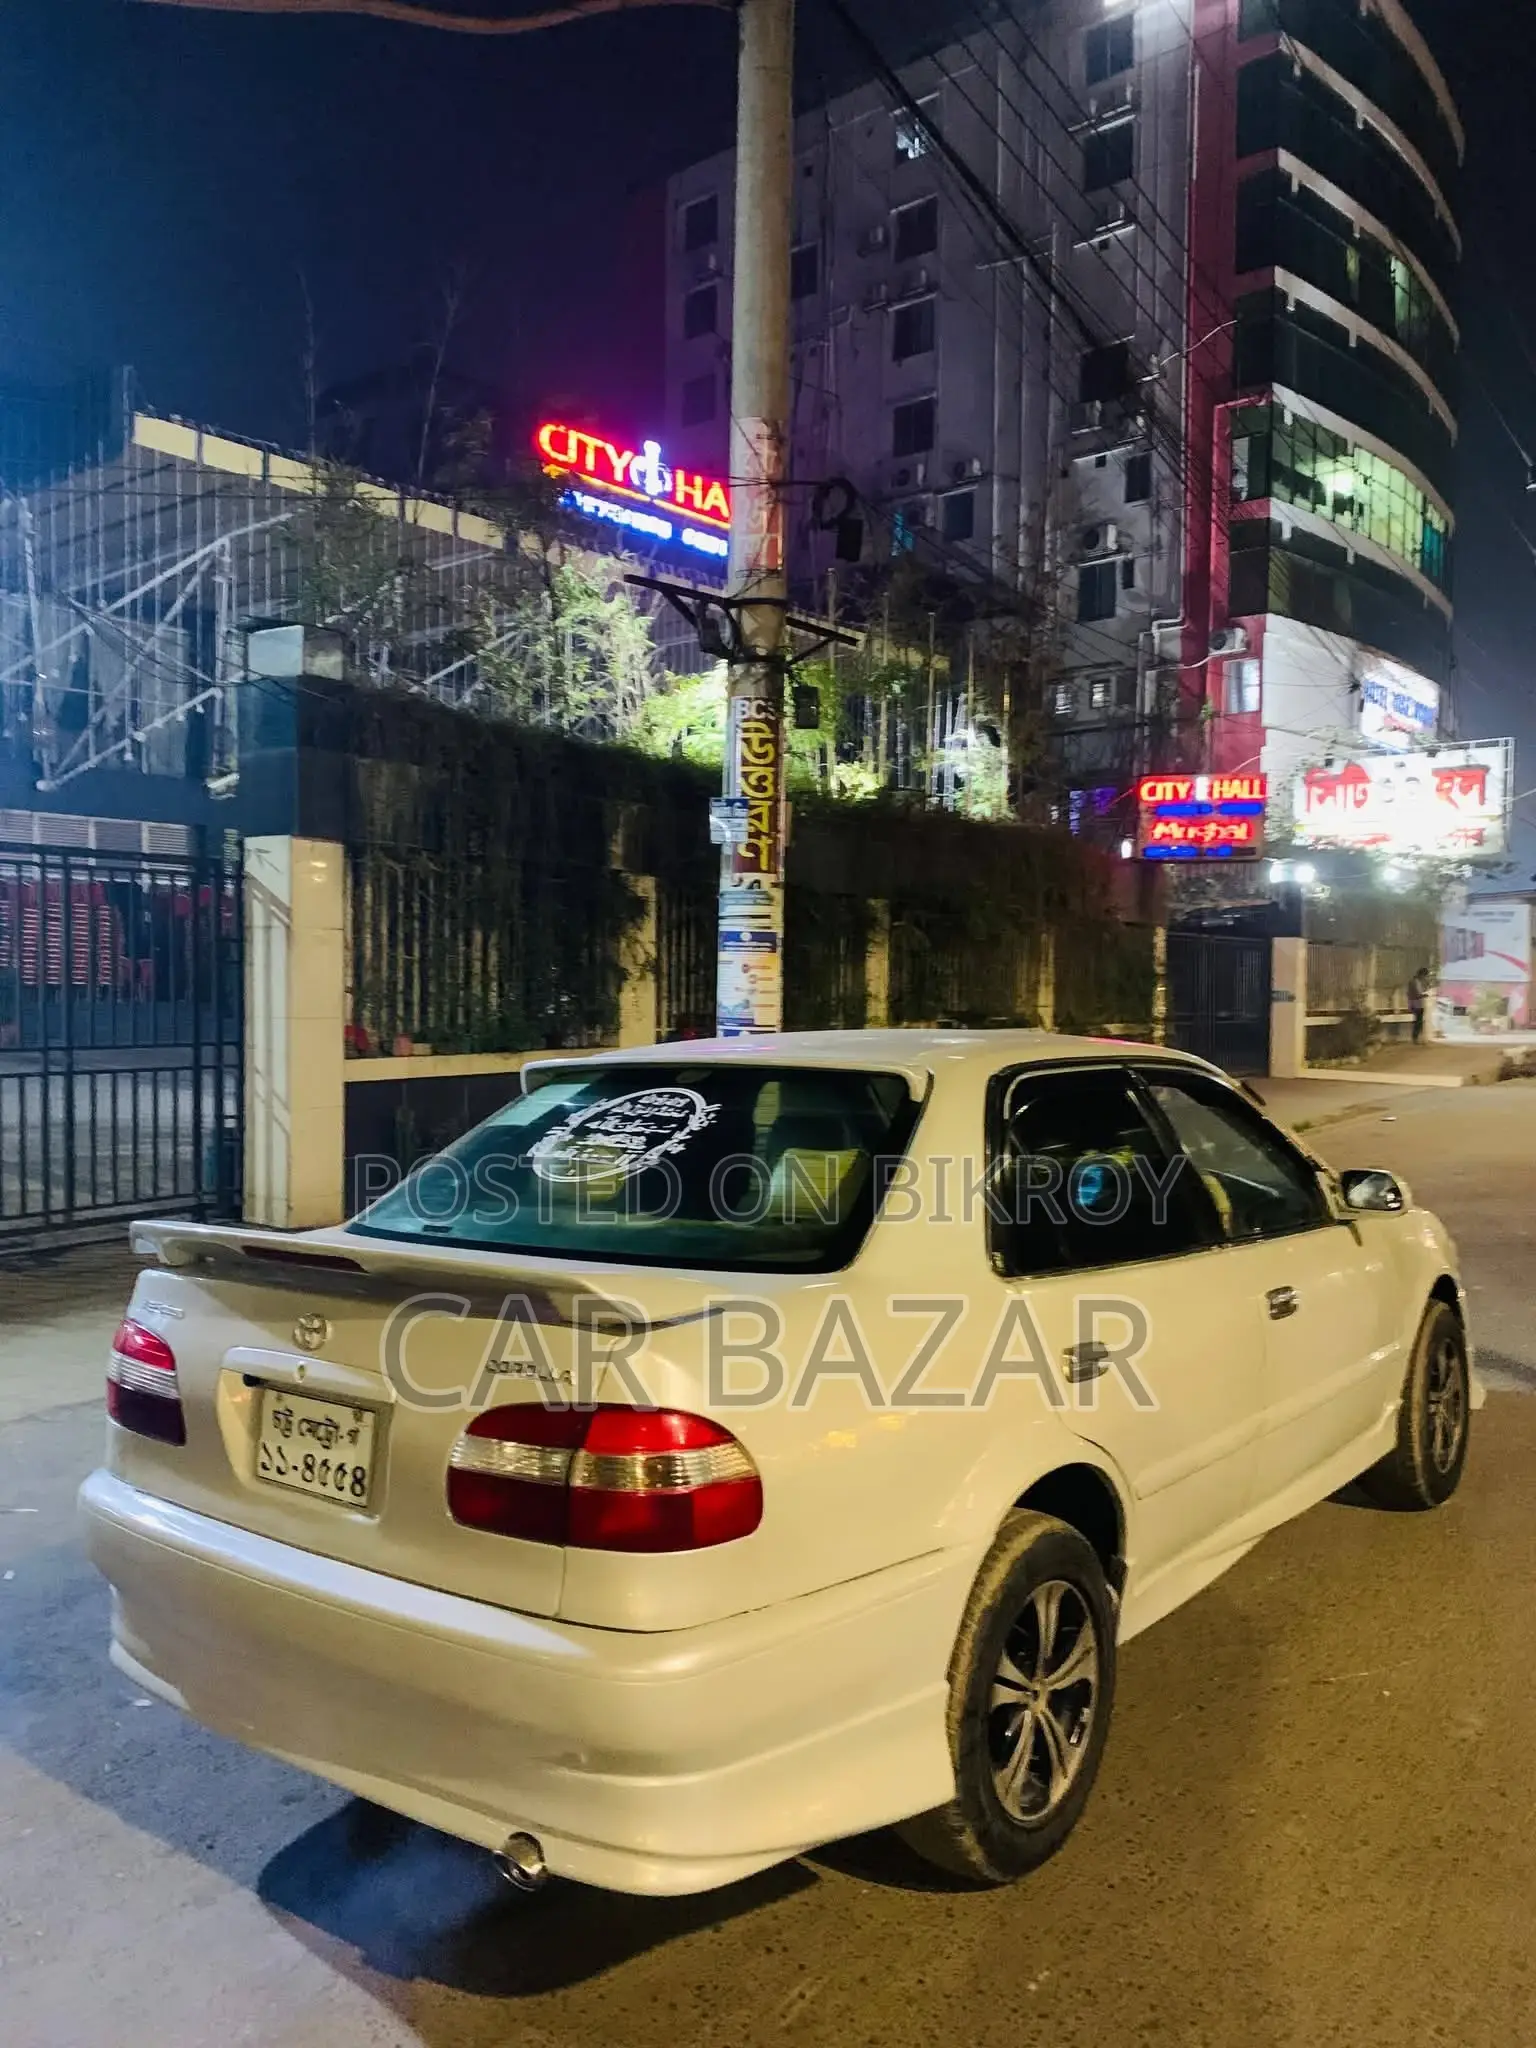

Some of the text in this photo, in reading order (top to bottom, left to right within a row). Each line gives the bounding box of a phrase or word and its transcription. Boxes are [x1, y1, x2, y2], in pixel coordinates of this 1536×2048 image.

[540, 423, 633, 482] CITY
[675, 469, 730, 517] HA
[1140, 778, 1264, 801] CITY HALL
